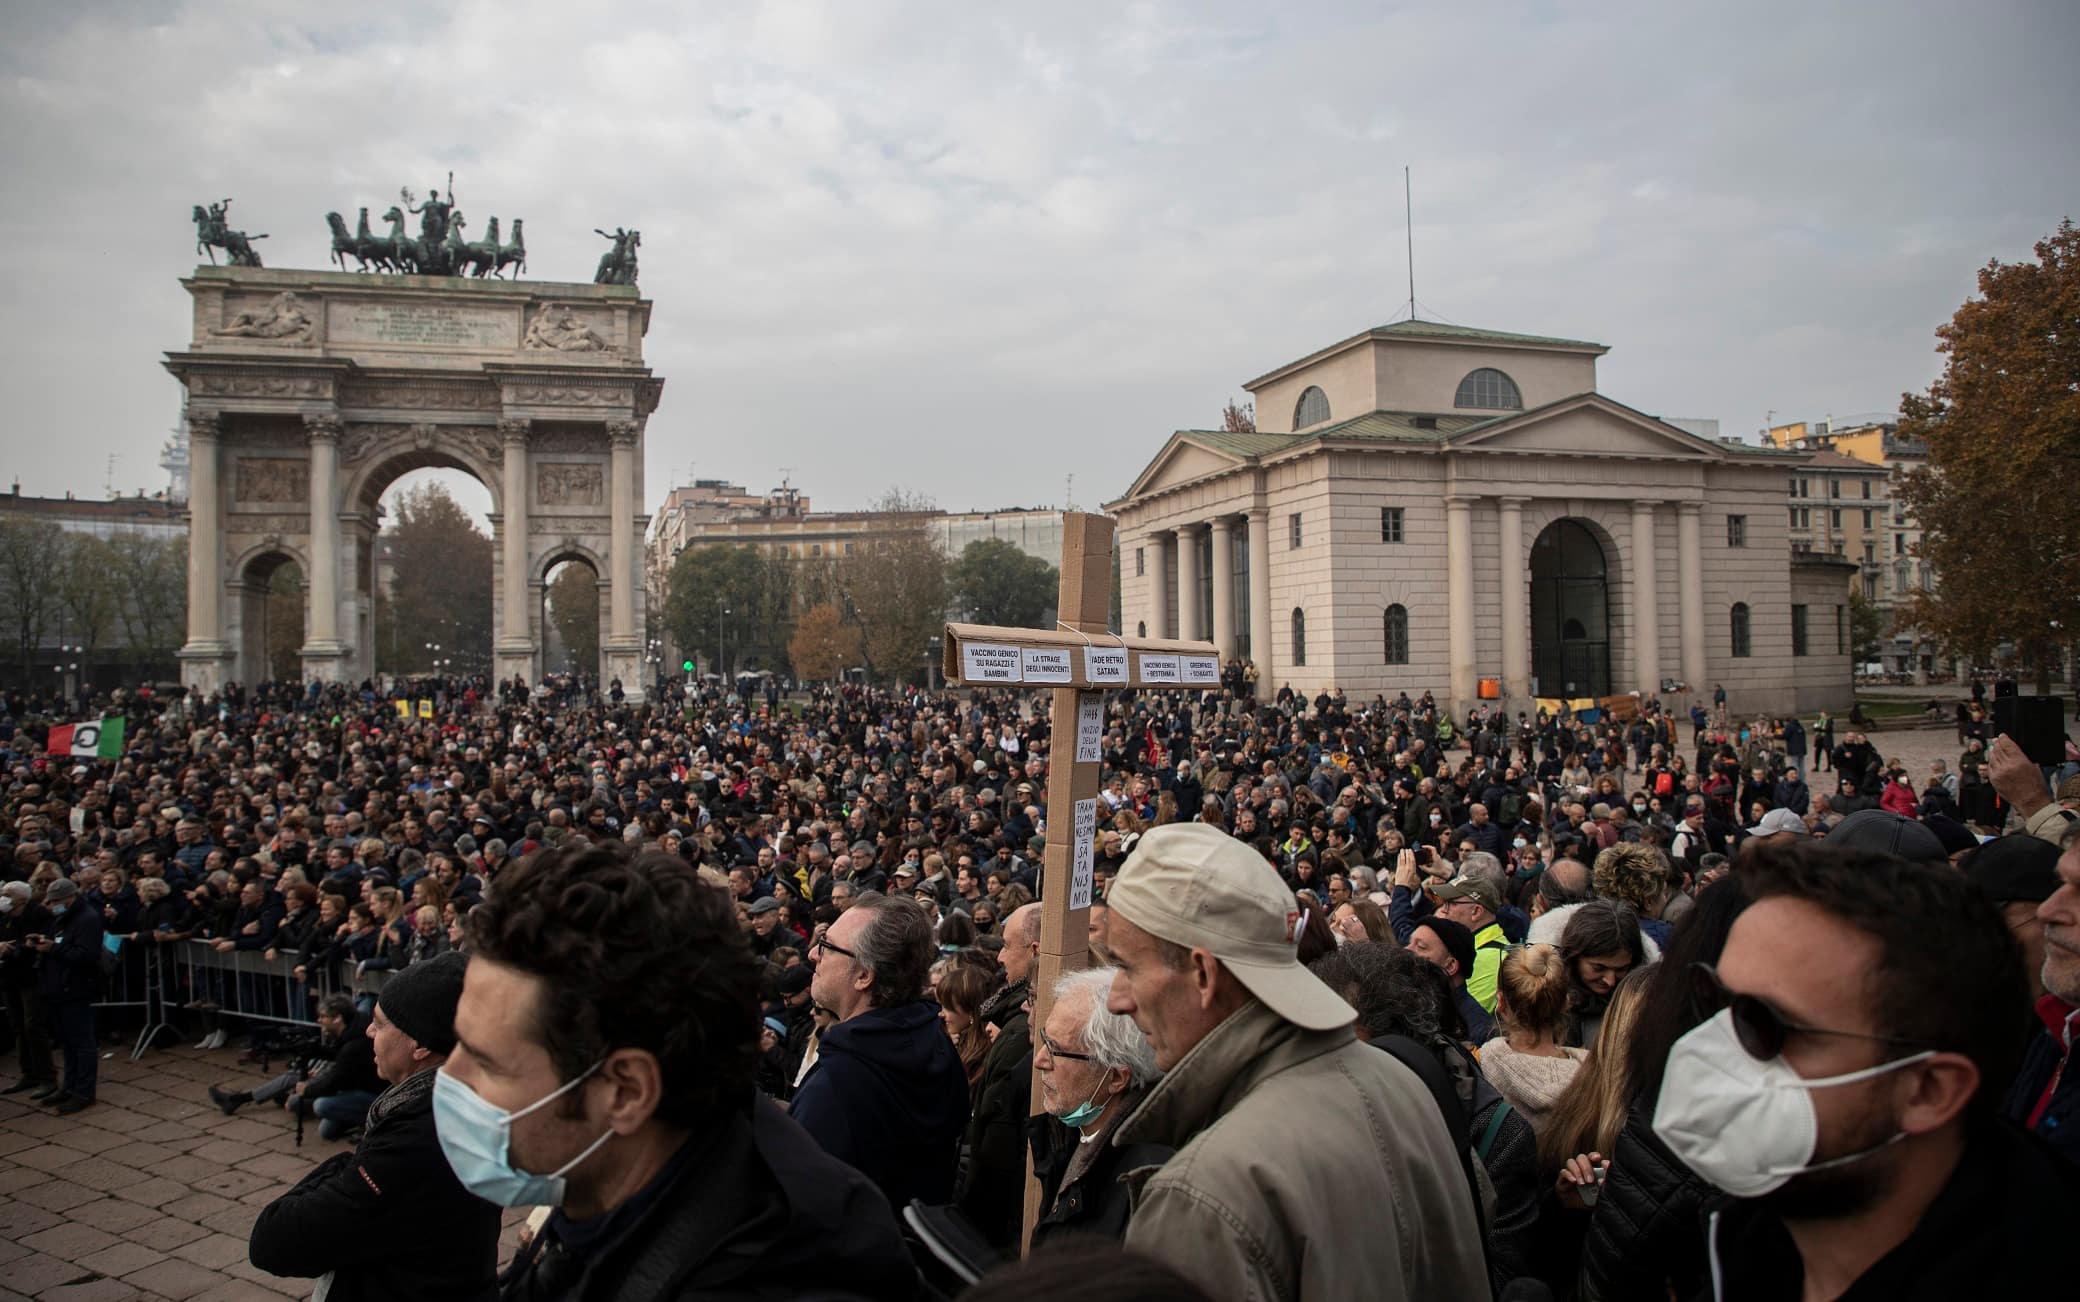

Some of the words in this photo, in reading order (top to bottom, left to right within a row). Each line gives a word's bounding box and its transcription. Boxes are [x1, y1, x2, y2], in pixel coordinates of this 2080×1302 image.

[970, 648, 997, 657] VACCINO
[997, 649, 1019, 658] GENICO
[976, 659, 985, 667] SU
[985, 659, 1010, 668] RAGAZZI
[1010, 660, 1015, 668] E
[1032, 655, 1040, 663] LA
[1040, 655, 1061, 663] STRAGE
[1105, 656, 1124, 665] RETRO
[1025, 664, 1041, 672] DEGLI
[1041, 665, 1070, 673] INNOCENTI
[1096, 667, 1120, 676] SATANA
[984, 669, 1009, 678] BAMBINI
[1081, 725, 1100, 735] INIZIO
[1082, 736, 1097, 745] DELLA
[1080, 746, 1097, 760] FINE
[1077, 845, 1088, 859] SA
[1077, 859, 1087, 872] TA
[1073, 873, 1089, 888] NIS
[1072, 890, 1088, 905] MO
